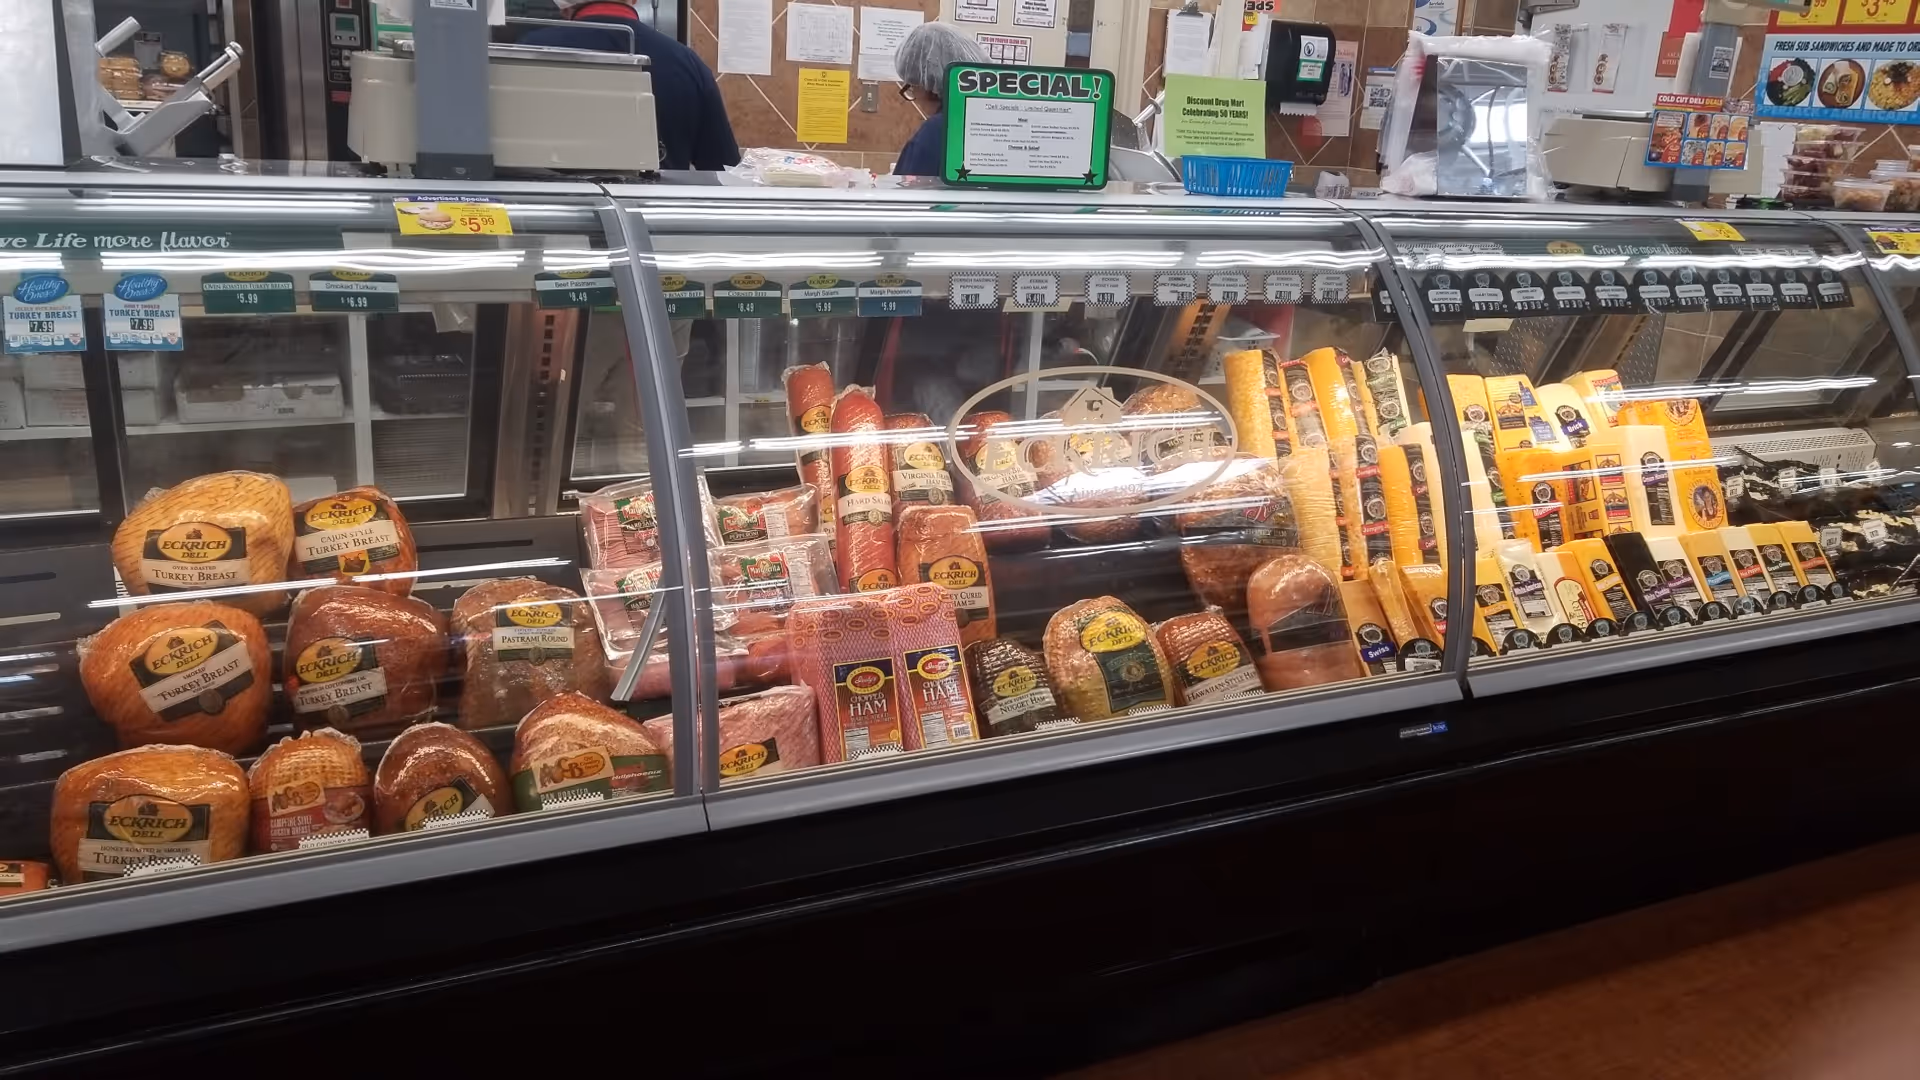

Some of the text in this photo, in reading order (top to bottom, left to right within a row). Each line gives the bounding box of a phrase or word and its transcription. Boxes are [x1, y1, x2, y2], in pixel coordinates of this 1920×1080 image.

[1774, 41, 1907, 52] FRESH SUB SANDWICHES AND MADE TO
[958, 69, 1102, 99] SPECIAL!
[1186, 96, 1244, 107] Discount Drug Mart
[1676, 96, 1688, 104] CUT
[1705, 98, 1722, 106] DEALS
[1182, 107, 1248, 119] Celebrating 50 YEARS!
[34, 232, 87, 248] Life
[93, 234, 153, 249] more
[1593, 244, 1617, 255] Give
[1617, 244, 1639, 255] Life
[18, 280, 64, 294] Healthy
[117, 277, 162, 291] Healthy
[204, 282, 220, 290] OVEN
[325, 282, 378, 292] Smoked Turkey
[554, 280, 596, 288] Beef Pastrami
[24, 288, 57, 302] Ones
[124, 287, 156, 299] Ones
[886, 288, 912, 296] Pepperoni
[9, 312, 42, 320] TURKEY
[109, 309, 175, 318] TURKEY BREAST
[1566, 422, 1584, 432] Brick
[850, 477, 888, 487] ECKRICH
[901, 472, 936, 480] VIRGINIA
[847, 497, 870, 507] HARD
[310, 505, 373, 522] ECKRICH
[320, 528, 374, 544] CAJUN STYLE
[729, 531, 758, 540] PEPPERONI
[162, 540, 227, 552] ECKRICH
[306, 534, 390, 557] TURKEY BREAST
[152, 568, 238, 582] TURKEY BREAST
[933, 569, 977, 580] ECKRICH
[959, 591, 983, 600] CURED
[511, 608, 559, 618] ECKRICH
[501, 634, 568, 644] PASTRAMI ROUND
[152, 634, 215, 671] ECKRICH
[1367, 646, 1390, 658] Swiss
[175, 651, 202, 669] DELI
[299, 650, 357, 675] ECKRICH
[1193, 651, 1239, 673] ECKRICH
[182, 666, 206, 681] SMOKED
[315, 667, 342, 679] DELI
[156, 658, 240, 701] TURKEY BREAST
[922, 678, 956, 689] CHOPPED
[997, 674, 1036, 692] ECKRICH
[299, 682, 373, 706] TURKEY BREAST
[850, 691, 885, 703] CHOPPED
[922, 684, 960, 702] HAM
[850, 699, 888, 716] HAM
[1000, 695, 1047, 714] NUGGET HAM
[720, 751, 765, 771] ECKRICH
[611, 769, 662, 780] Hillphoenix
[557, 788, 589, 799] ROASTED
[108, 815, 188, 829] ECKRICH
[270, 815, 312, 828] CAMPFIRE STYLE
[131, 830, 165, 838] DELI
[270, 826, 312, 836] CHICKEN BREAST
[93, 852, 147, 864] TURKEY
